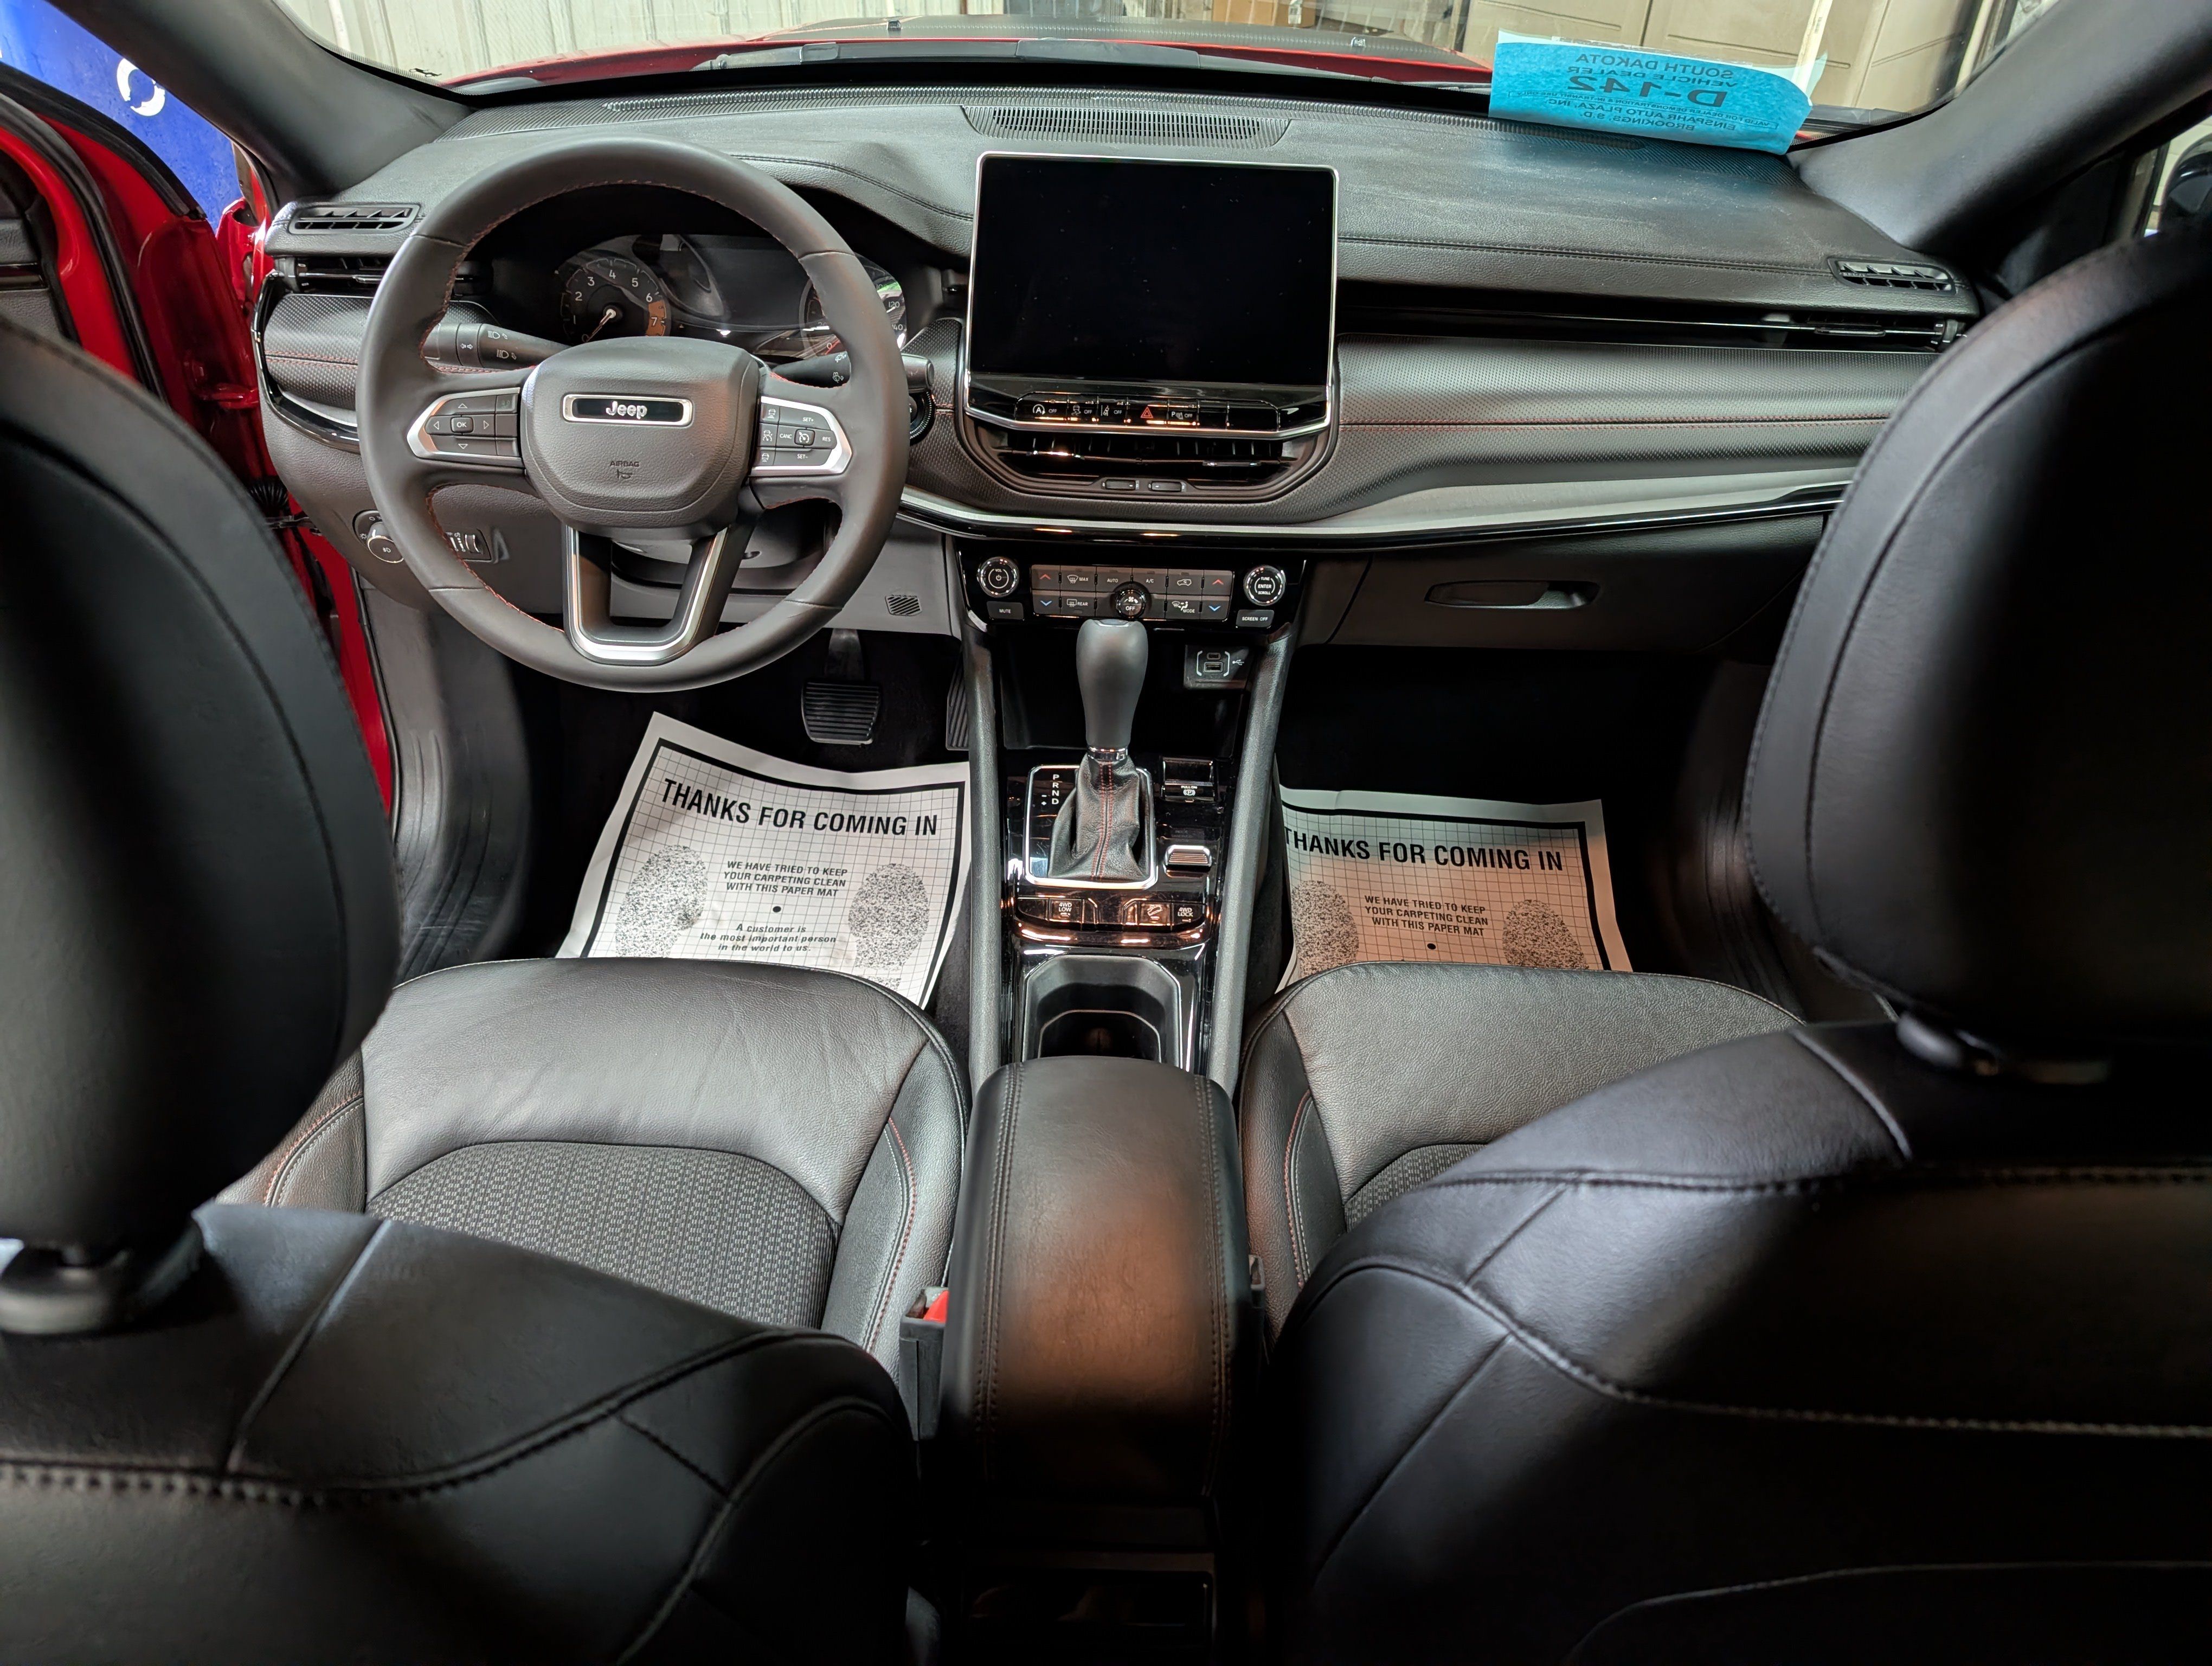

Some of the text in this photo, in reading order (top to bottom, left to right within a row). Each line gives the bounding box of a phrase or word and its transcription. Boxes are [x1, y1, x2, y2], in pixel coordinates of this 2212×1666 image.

[587, 277, 595, 286] 3
[609, 270, 616, 279] 4
[632, 277, 639, 287] 5
[575, 291, 582, 302] 2
[646, 293, 652, 302] 6
[651, 317, 657, 326] 7
[606, 401, 647, 419] Jeep
[662, 778, 937, 836] THANKS FOR COMING IN
[1284, 826, 1562, 871] THANKS FOR COMING IN
[727, 861, 847, 876] WE HAVE TRIED TO KEEP
[724, 872, 846, 887] YOUR CARPETING CLEAN
[726, 882, 839, 896] WITH THIS PAPER MAT
[1365, 895, 1486, 914] WE HAVE TRIED TO KEEP
[1365, 906, 1488, 925] YOUR CARPETING CLEAN
[1372, 917, 1484, 936] WITH THIS PAPER MAT
[720, 933, 745, 942] most
